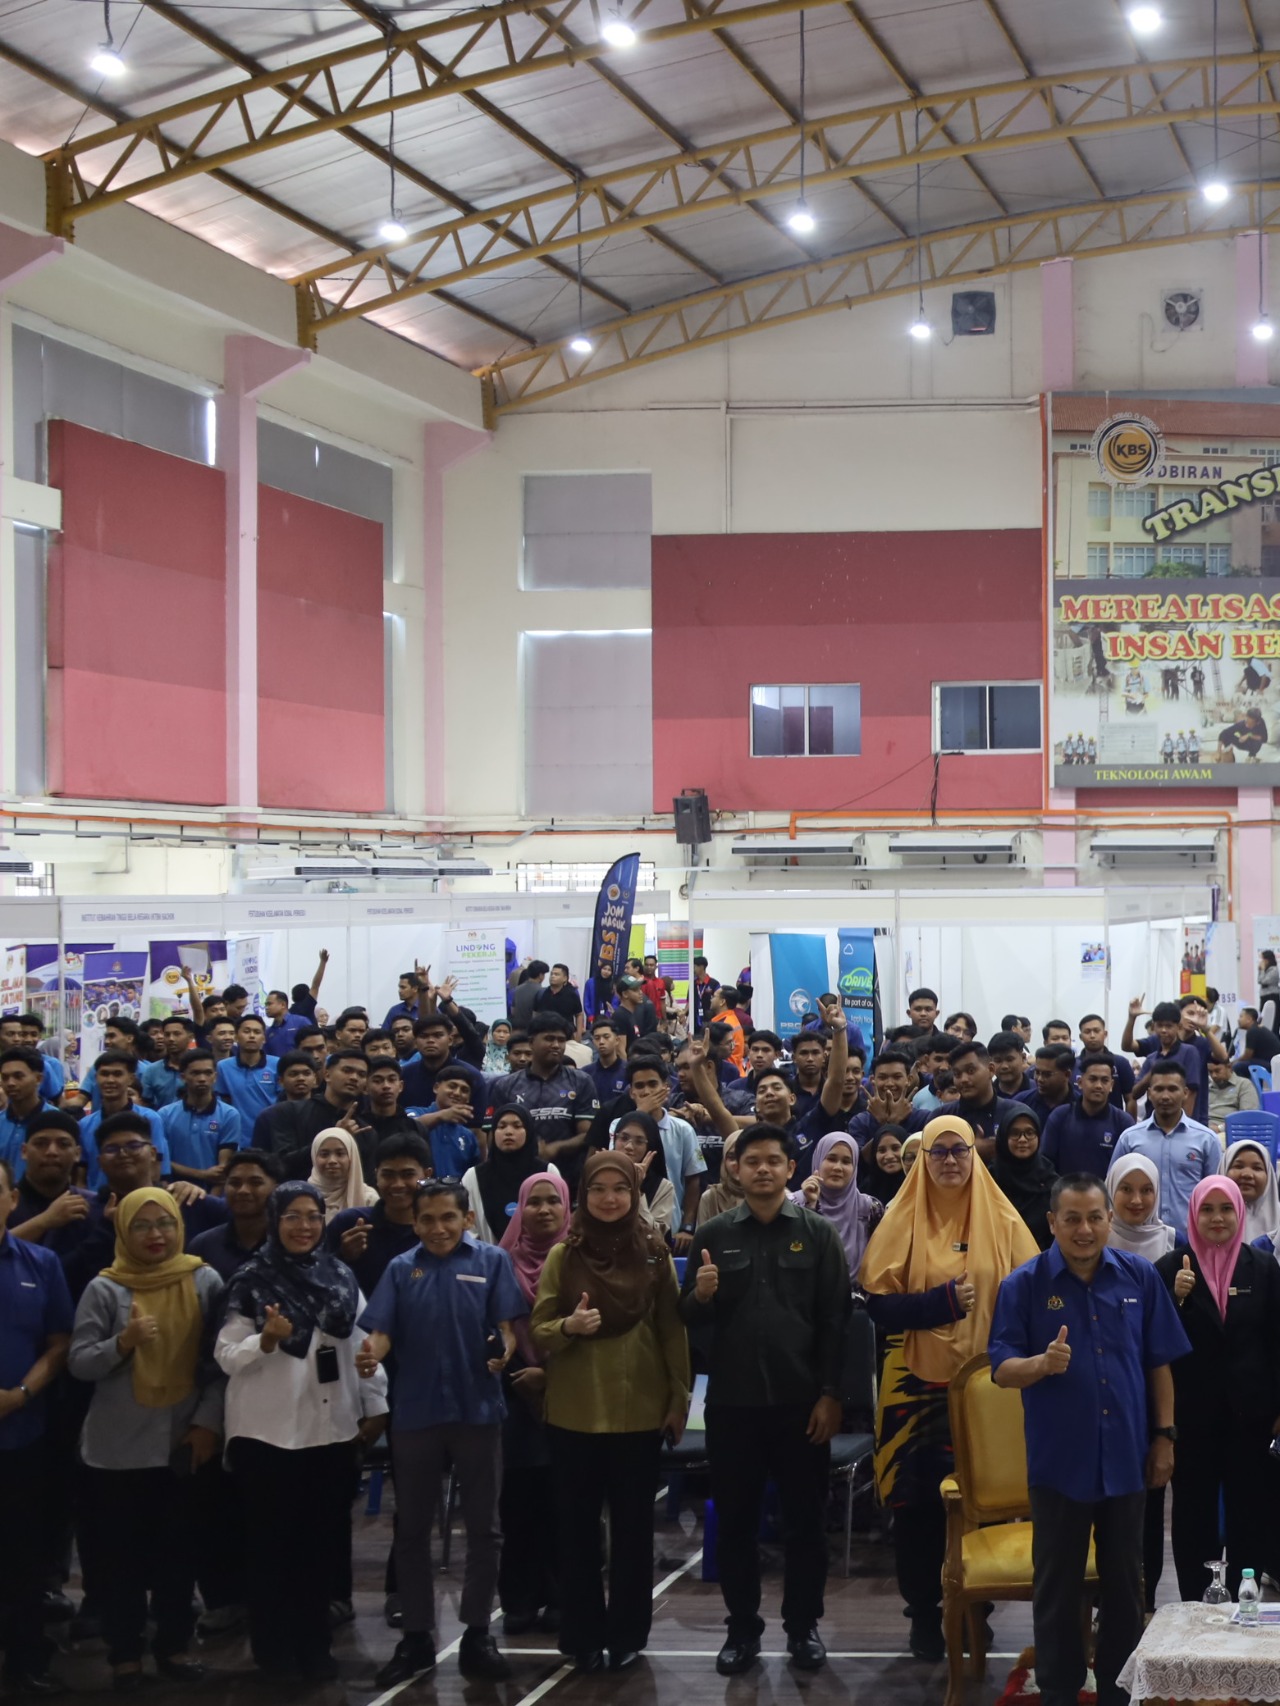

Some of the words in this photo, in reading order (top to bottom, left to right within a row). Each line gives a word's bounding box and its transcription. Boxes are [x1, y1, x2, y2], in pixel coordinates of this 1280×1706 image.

[1116, 443, 1147, 458] KBS
[1106, 631, 1225, 660] INSAN
[1094, 769, 1169, 781] TEKNOLOGI
[1171, 769, 1213, 780] AWAM
[603, 902, 625, 918] JOM
[601, 917, 626, 931] MASUK
[597, 930, 617, 967] BS
[845, 975, 873, 987] DRIVE
[530, 1107, 572, 1117] ESEL
